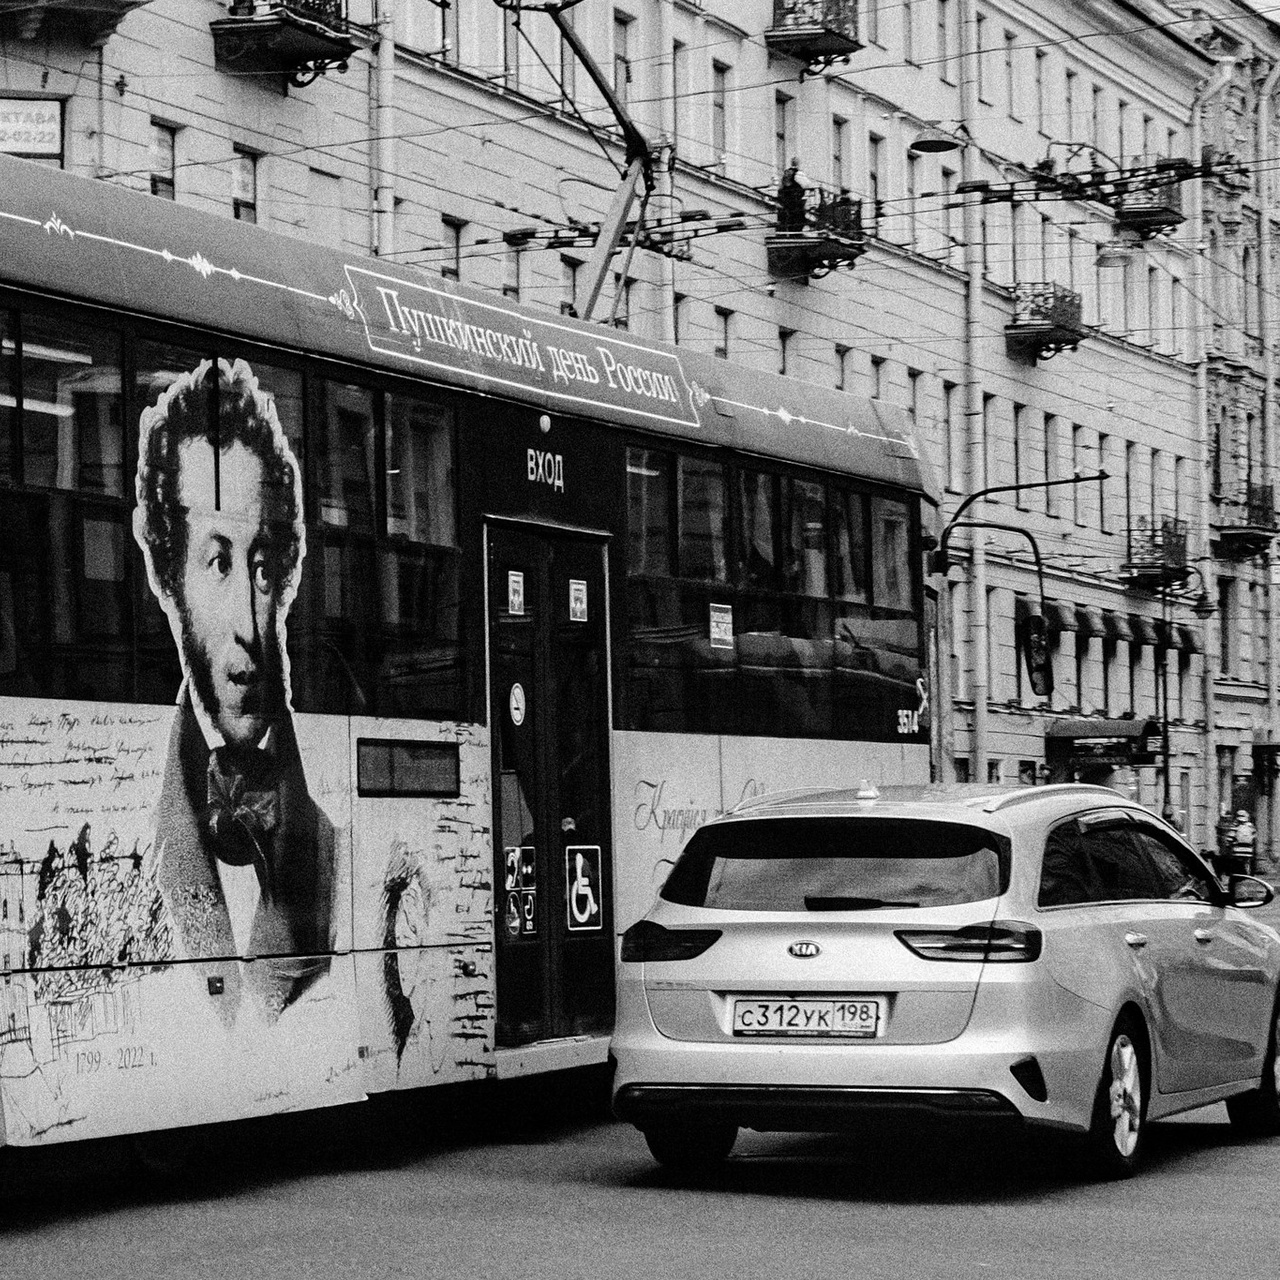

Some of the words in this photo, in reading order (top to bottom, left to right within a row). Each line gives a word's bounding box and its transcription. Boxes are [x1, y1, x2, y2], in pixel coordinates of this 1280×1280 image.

[376, 286, 546, 372] Пушкинский
[546, 345, 600, 386] день
[596, 346, 678, 404] России
[527, 448, 565, 494] ВХОД
[897, 709, 919, 734] 3514
[790, 942, 818, 957] KIA
[836, 1003, 870, 1022] 198
[76, 1050, 101, 1074] 1799
[117, 1045, 144, 1069] 2022
